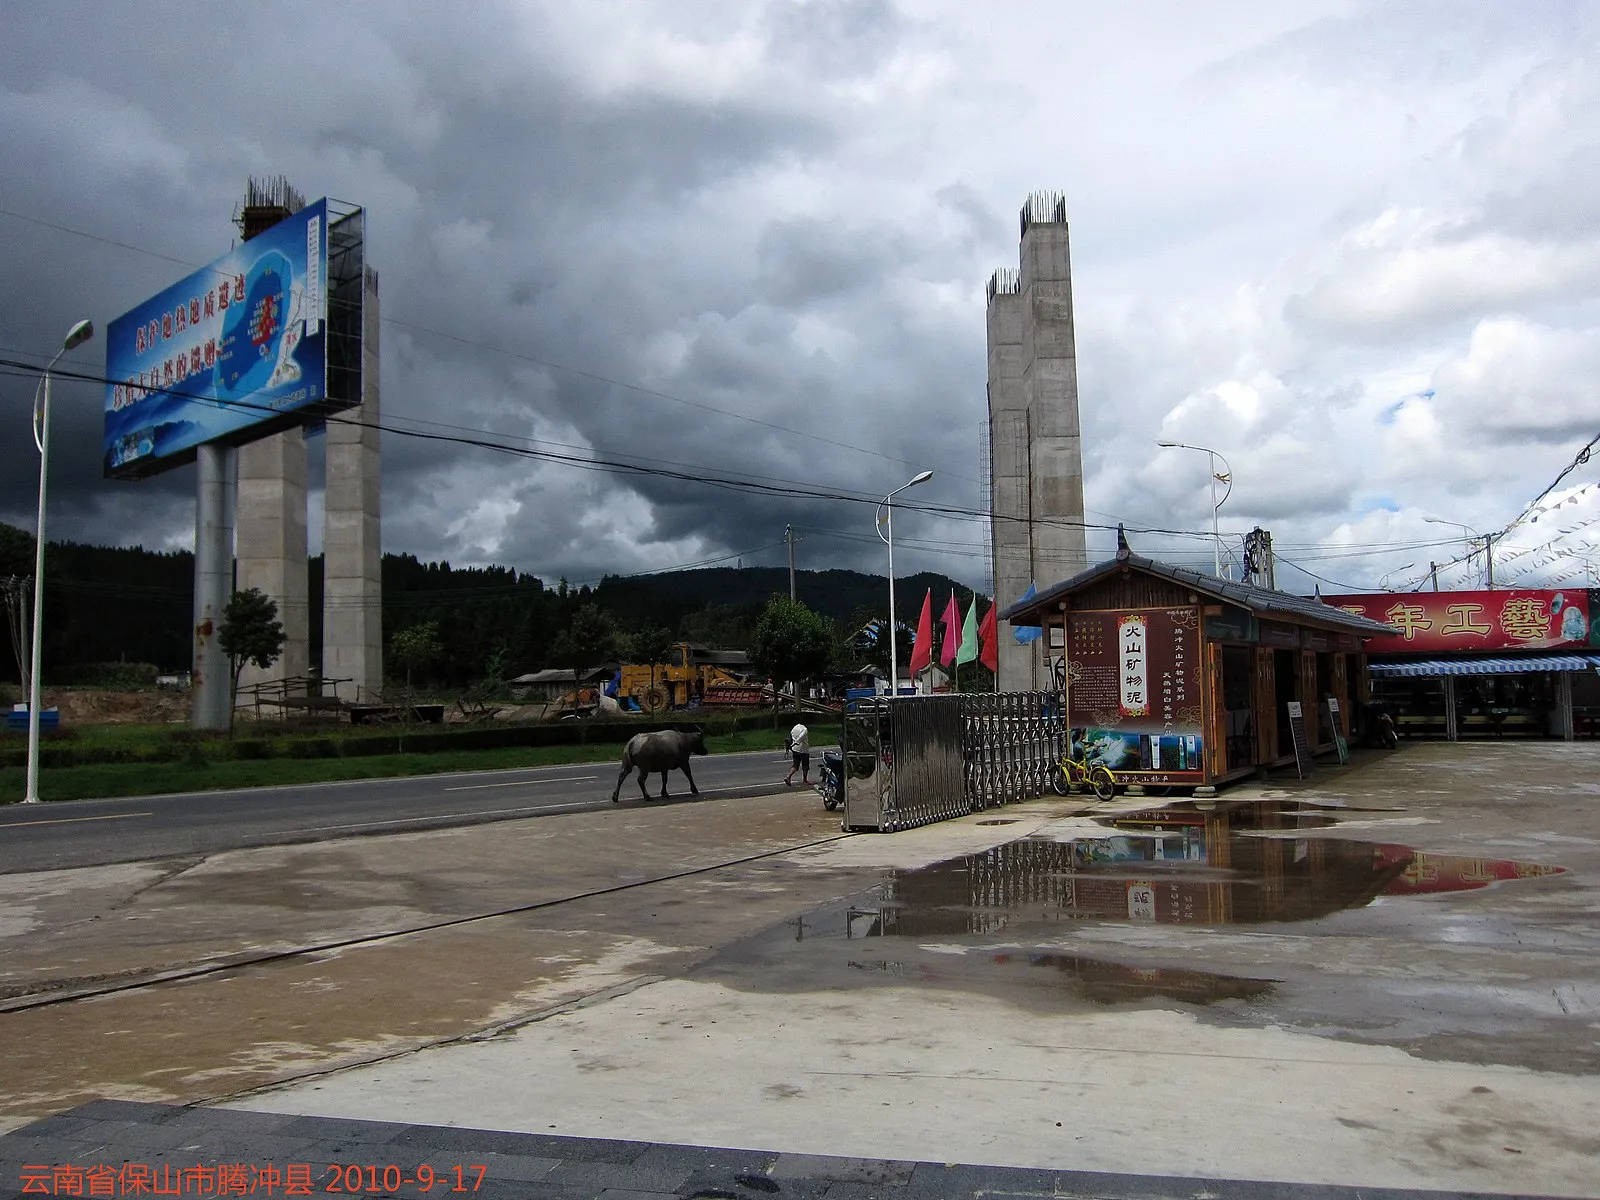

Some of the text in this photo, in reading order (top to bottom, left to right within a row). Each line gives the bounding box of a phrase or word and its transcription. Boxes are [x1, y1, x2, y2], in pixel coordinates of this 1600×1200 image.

[136, 273, 245, 355] 保护地热地质遗迹
[1125, 625, 1143, 704] 火山矿物泥
